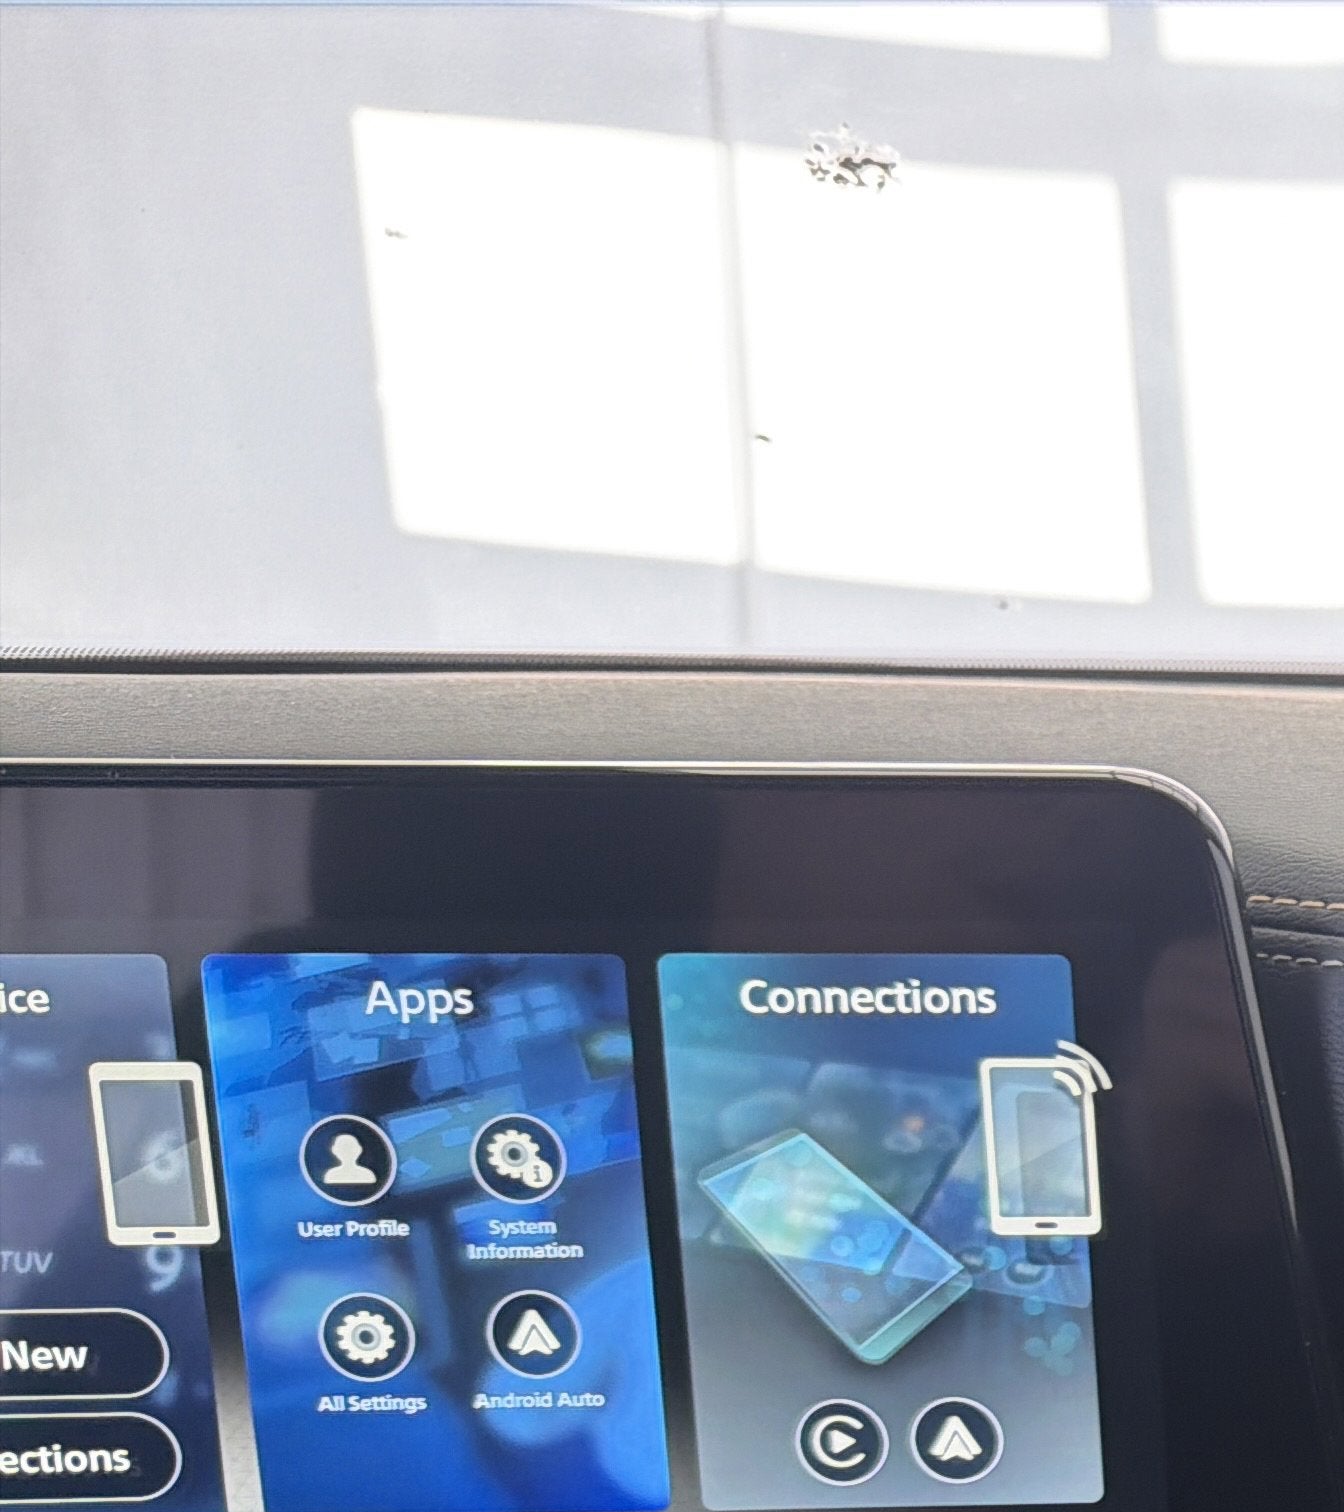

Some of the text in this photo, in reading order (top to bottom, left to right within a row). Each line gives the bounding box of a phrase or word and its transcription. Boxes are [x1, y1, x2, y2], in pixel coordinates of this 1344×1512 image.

[365, 980, 475, 1024] Apps
[740, 978, 998, 1015] Connections
[297, 1219, 411, 1238] User Profile
[488, 1219, 558, 1239] System
[466, 1241, 584, 1260] Information
[1, 1340, 88, 1371] New
[317, 1394, 428, 1414] All Settings
[472, 1391, 606, 1410] Android Auto
